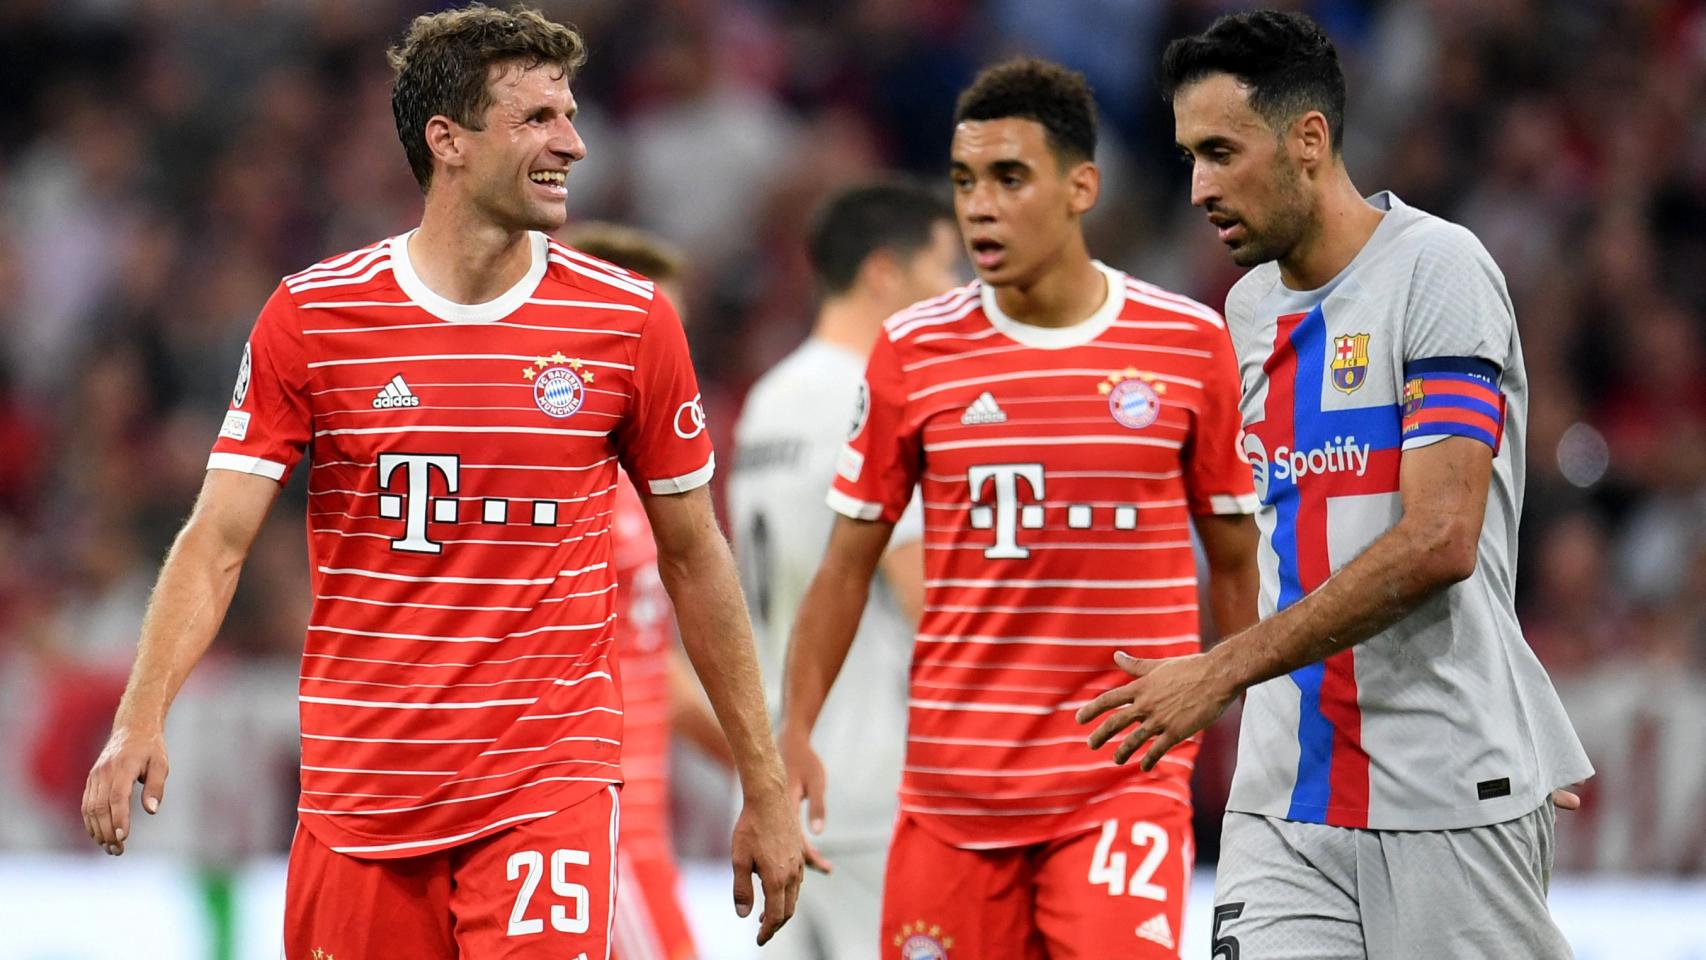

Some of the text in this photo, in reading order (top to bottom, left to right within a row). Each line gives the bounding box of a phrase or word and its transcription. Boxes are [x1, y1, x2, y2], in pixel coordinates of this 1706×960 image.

[372, 394, 419, 409] adidas
[547, 370, 579, 390] BAYERN
[1274, 435, 1370, 485] Spotify
[1088, 818, 1169, 902] 42
[506, 849, 590, 936] 25
[1211, 901, 1246, 960] 5
